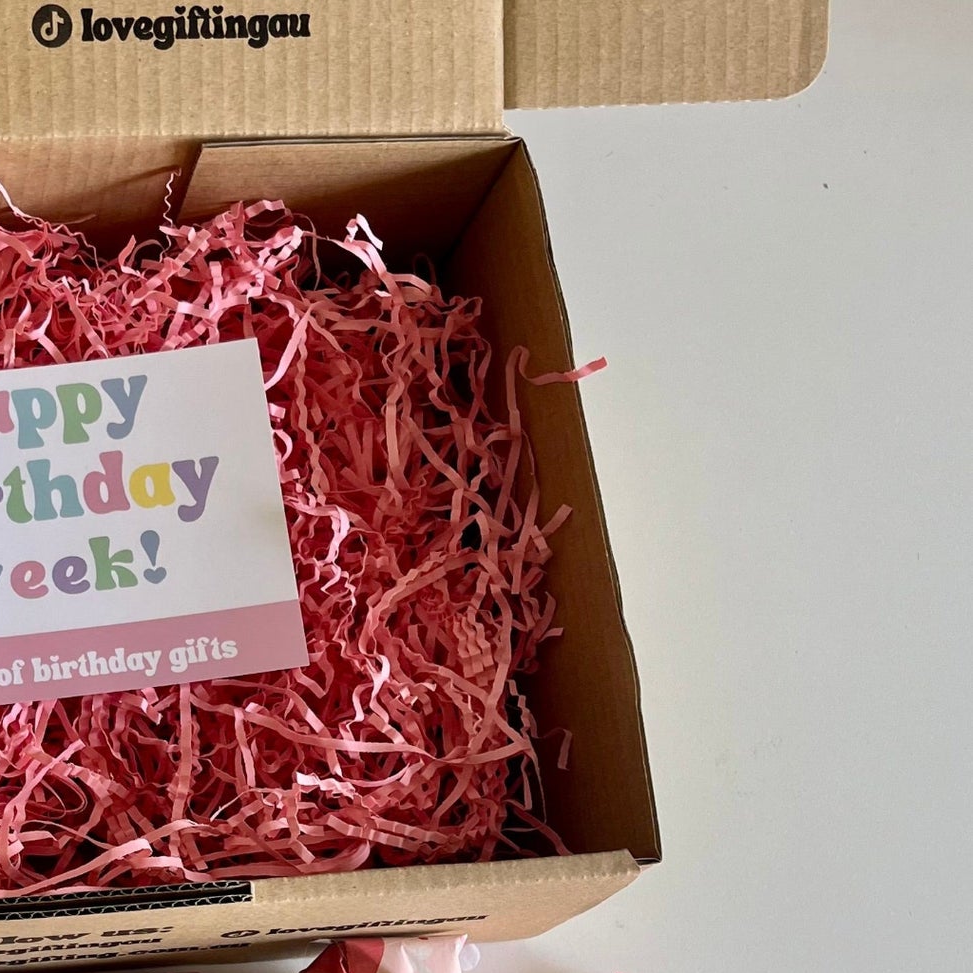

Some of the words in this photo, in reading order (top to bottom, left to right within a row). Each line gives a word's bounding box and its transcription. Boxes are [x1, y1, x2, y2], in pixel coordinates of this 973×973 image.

[81, 6, 311, 49] lovegiftingau
[33, 648, 162, 684] birthday
[168, 636, 239, 673] gifts
[100, 926, 175, 938] us:
[265, 914, 490, 935] lovegiftingau
